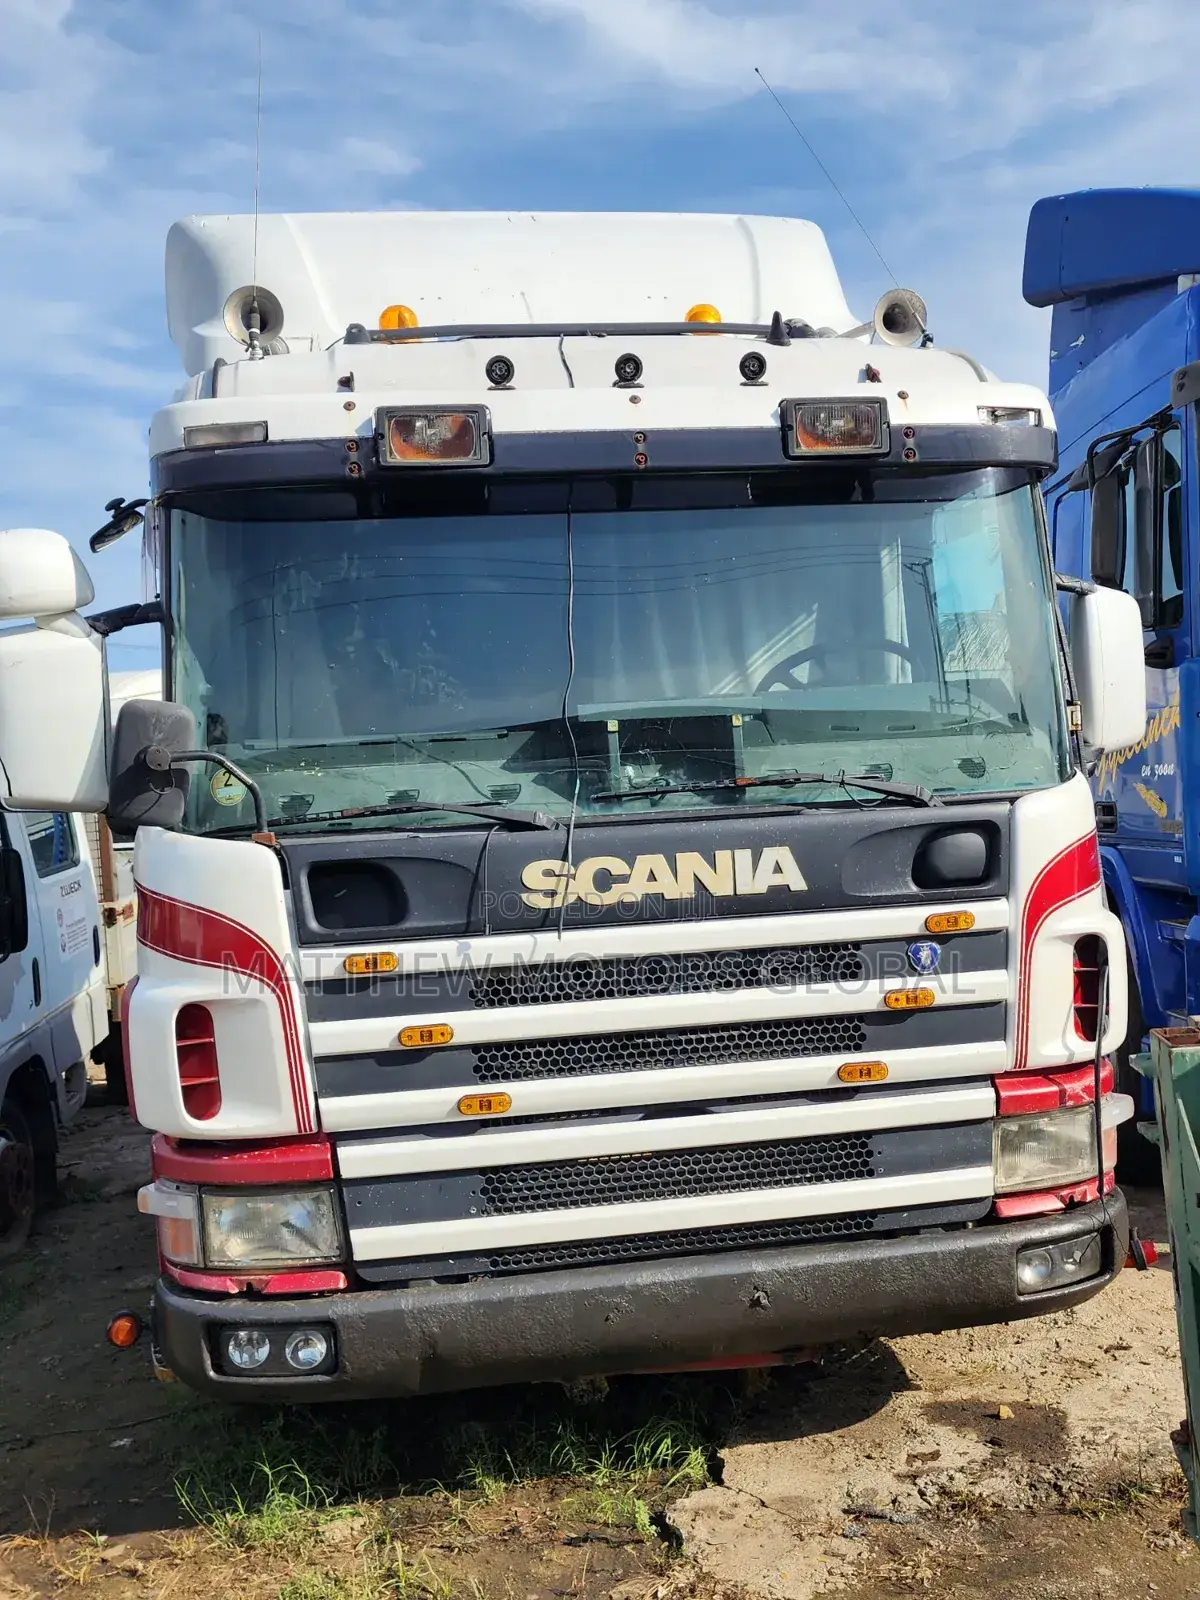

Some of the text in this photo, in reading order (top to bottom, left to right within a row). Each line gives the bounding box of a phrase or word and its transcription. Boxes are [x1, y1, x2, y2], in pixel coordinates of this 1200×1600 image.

[1141, 765, 1152, 777] en
[521, 845, 808, 910] SCANIA
[60, 879, 81, 898] ZWECK
